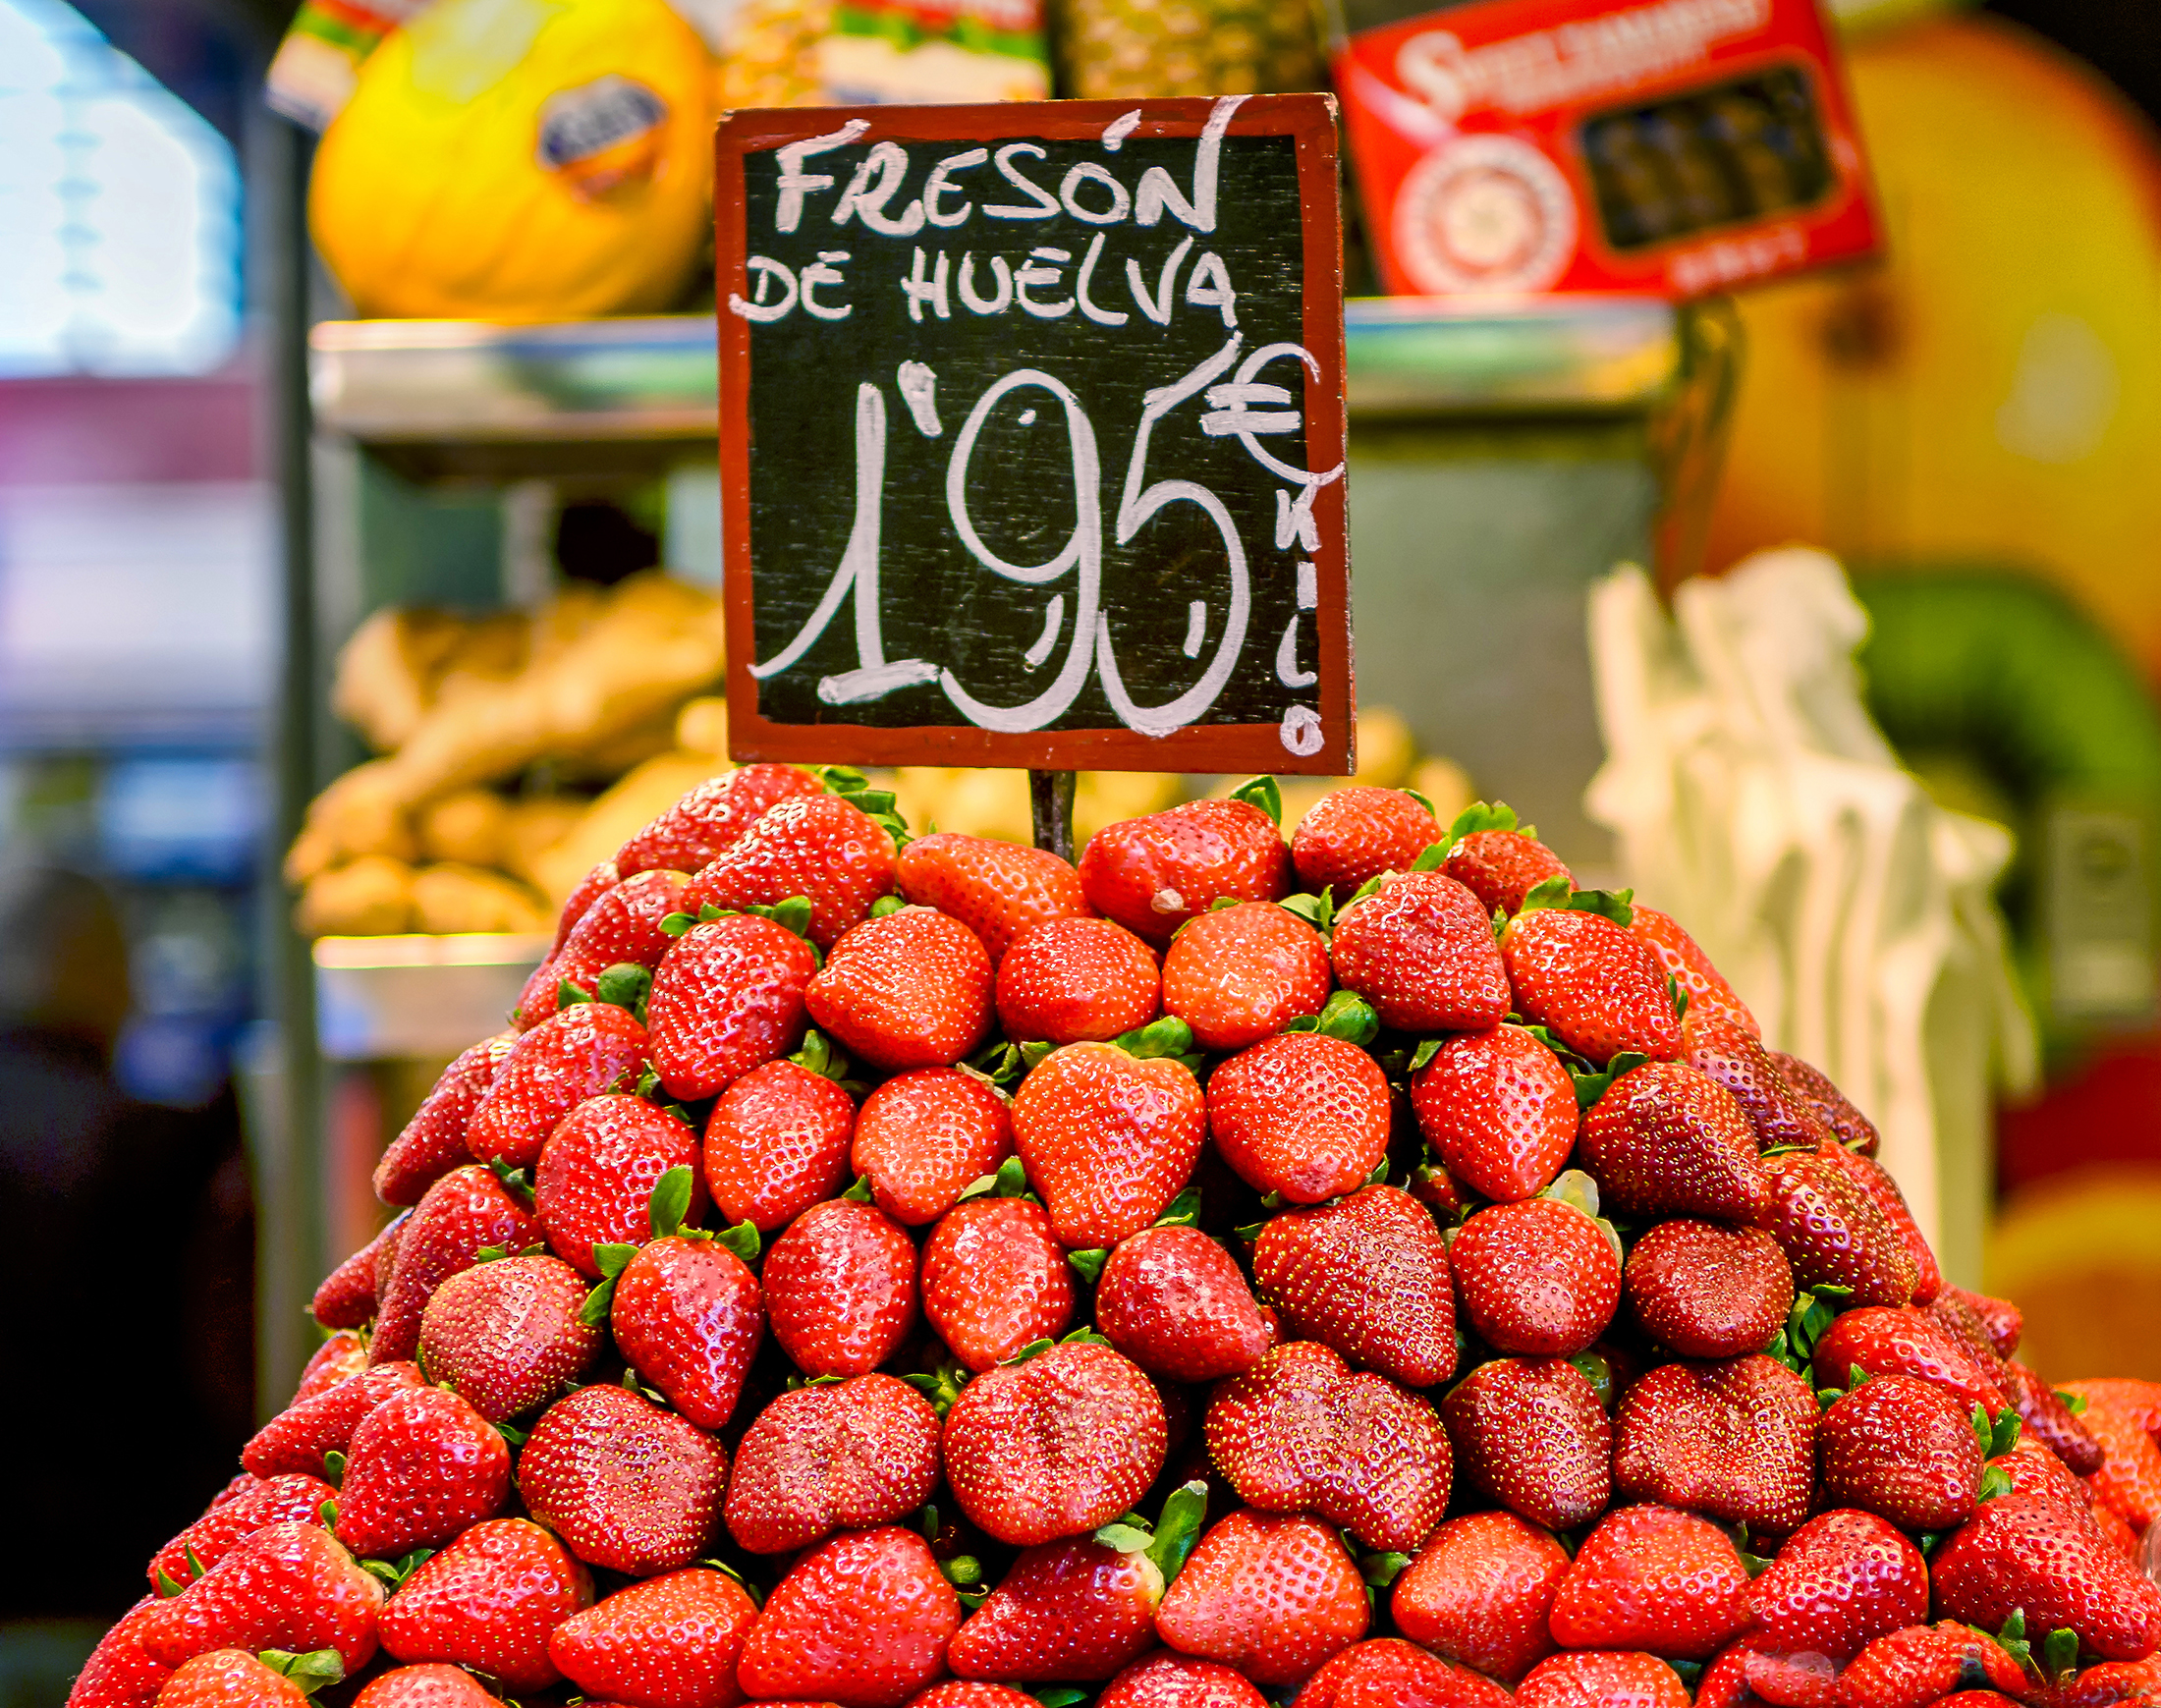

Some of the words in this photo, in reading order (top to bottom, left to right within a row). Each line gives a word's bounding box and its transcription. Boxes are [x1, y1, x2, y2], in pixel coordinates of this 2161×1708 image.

[776, 94, 1253, 235] FRESÓN
[730, 251, 852, 321] DE
[902, 232, 1238, 328] HUELVA
[1276, 479, 1325, 756] KILO
